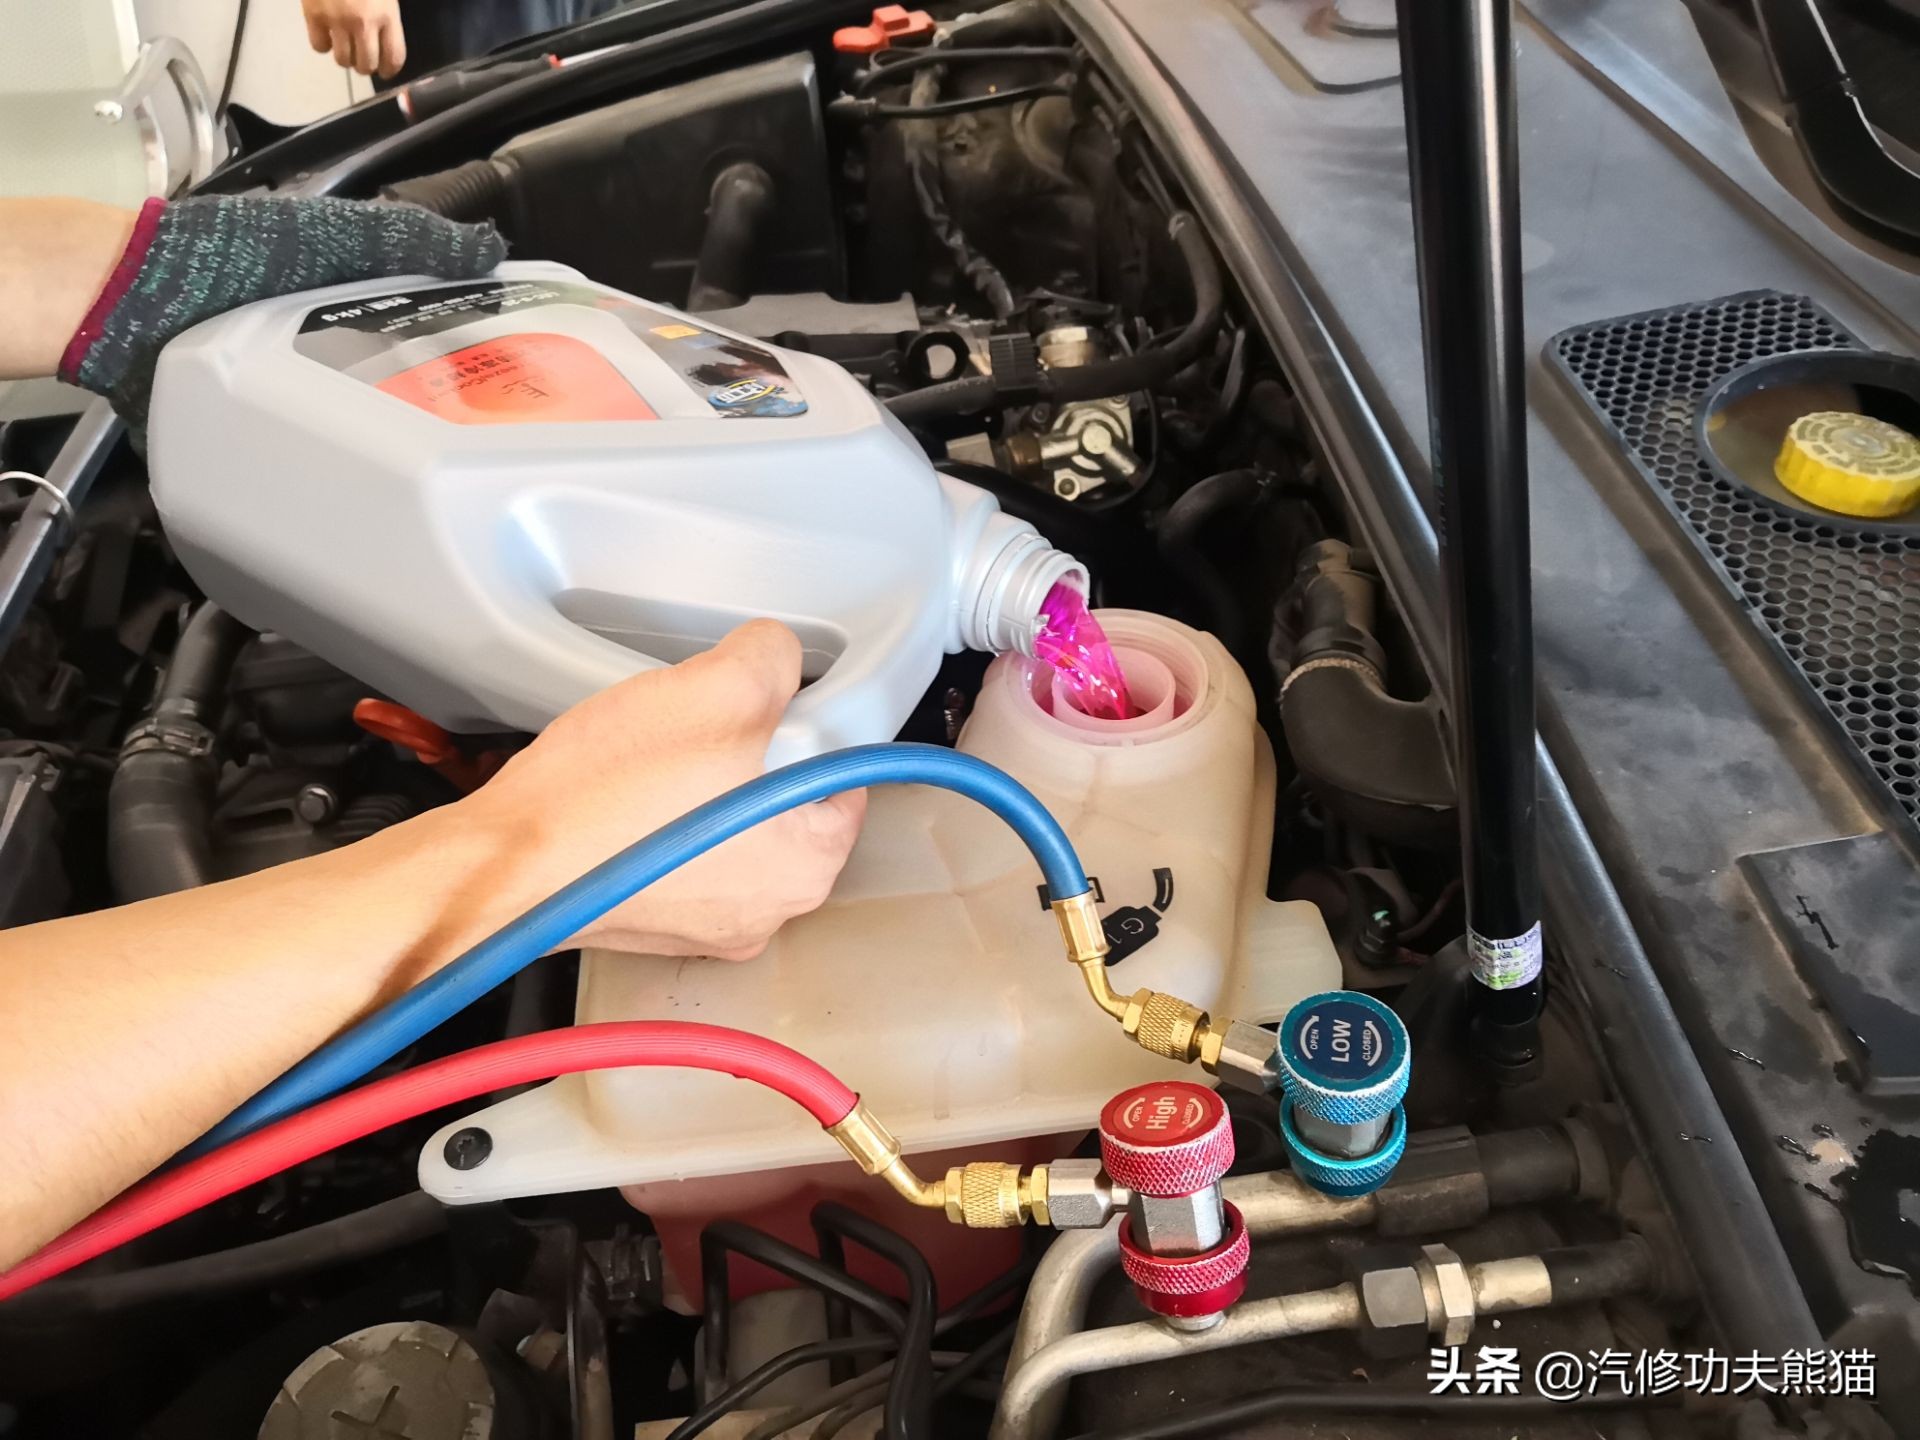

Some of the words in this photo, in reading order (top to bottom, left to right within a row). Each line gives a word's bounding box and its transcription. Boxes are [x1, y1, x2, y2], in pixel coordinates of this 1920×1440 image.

[1309, 1028, 1320, 1051] OPEN
[1330, 1019, 1352, 1063] LOW
[1361, 1028, 1372, 1062] CLOSED
[1145, 1096, 1179, 1130] High
